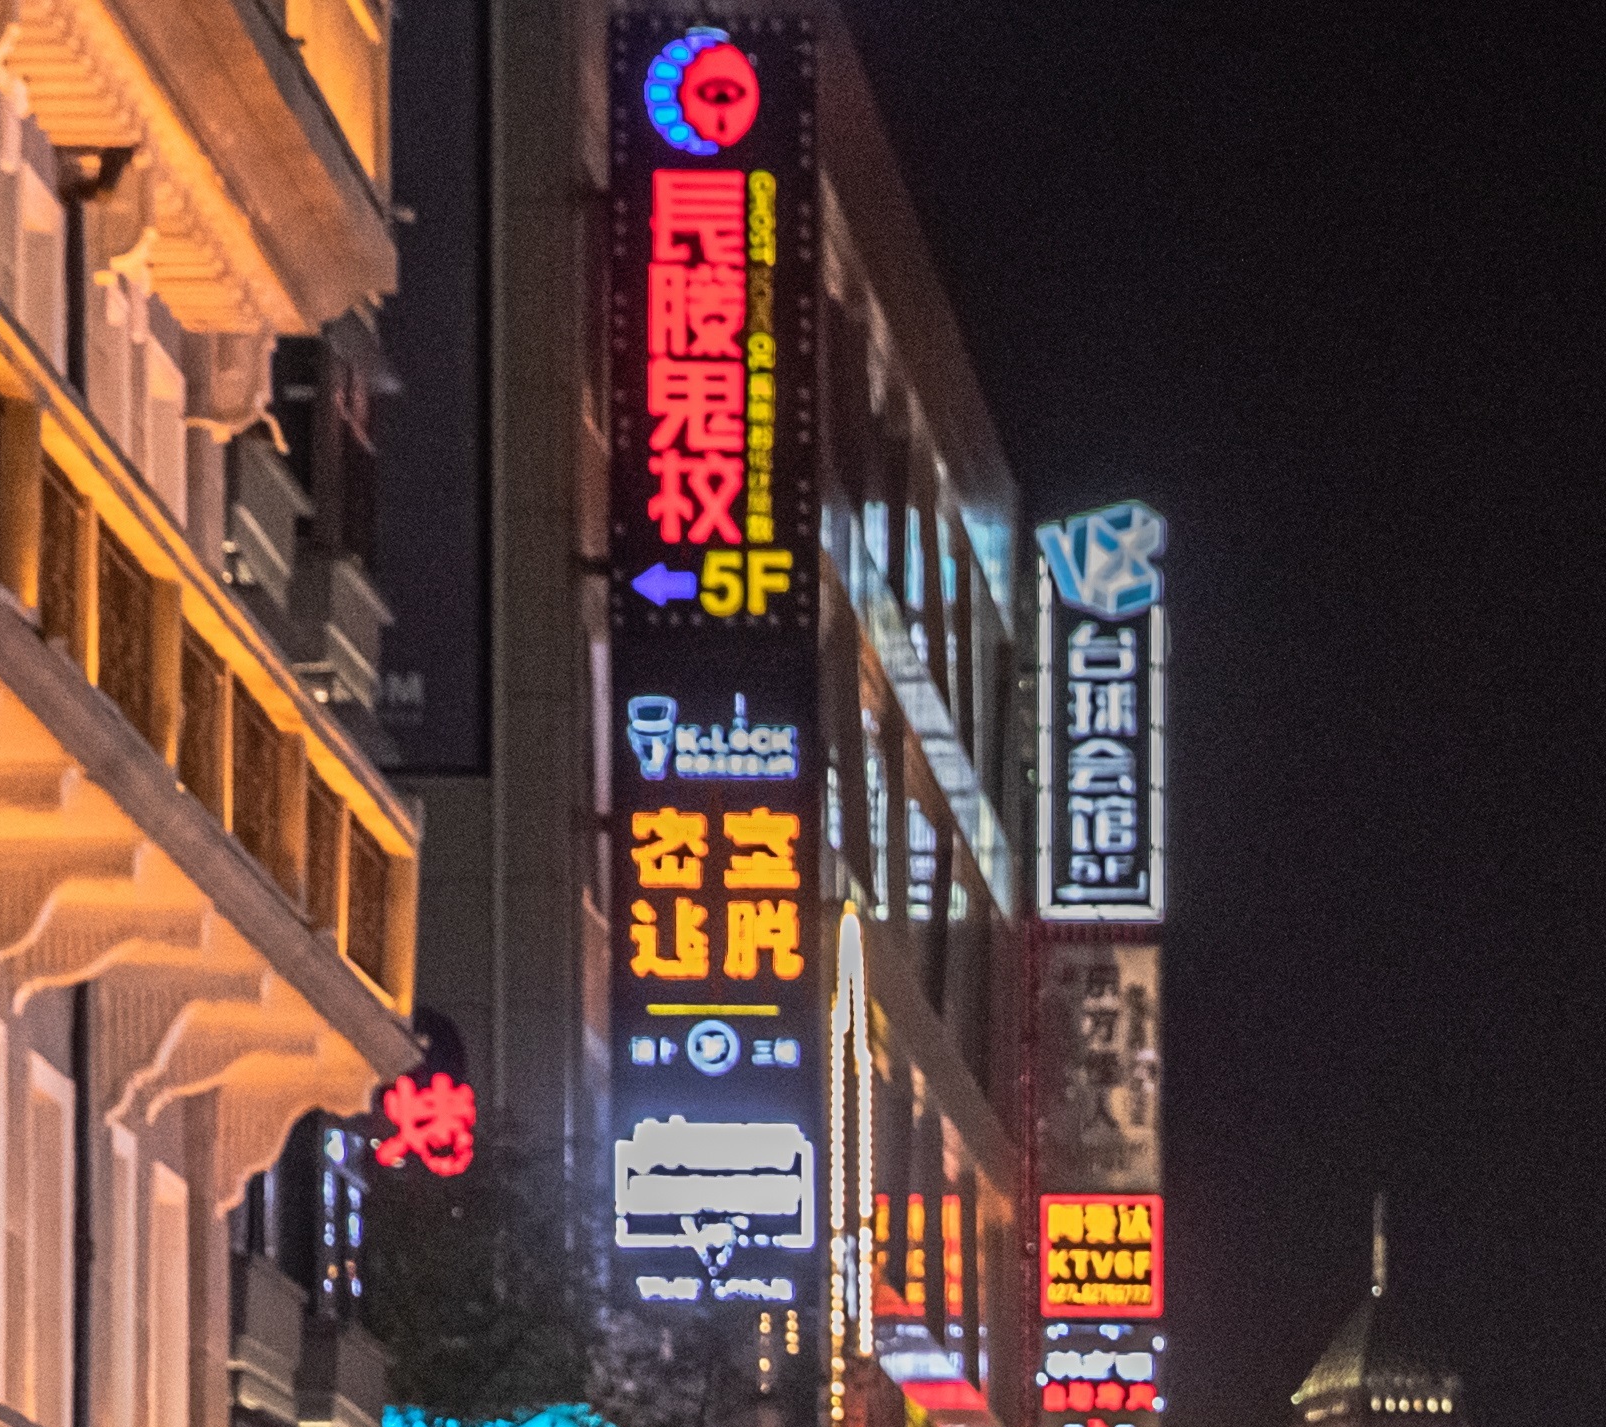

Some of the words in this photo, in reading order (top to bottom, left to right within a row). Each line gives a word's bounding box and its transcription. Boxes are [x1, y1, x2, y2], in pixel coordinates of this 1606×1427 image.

[699, 550, 794, 617] 5F
[1067, 620, 1138, 854] 台球会馆
[630, 807, 802, 889] 密室
[1068, 856, 1137, 884] 5F
[630, 897, 805, 981] 逃脱
[376, 1072, 477, 1177] 烤
